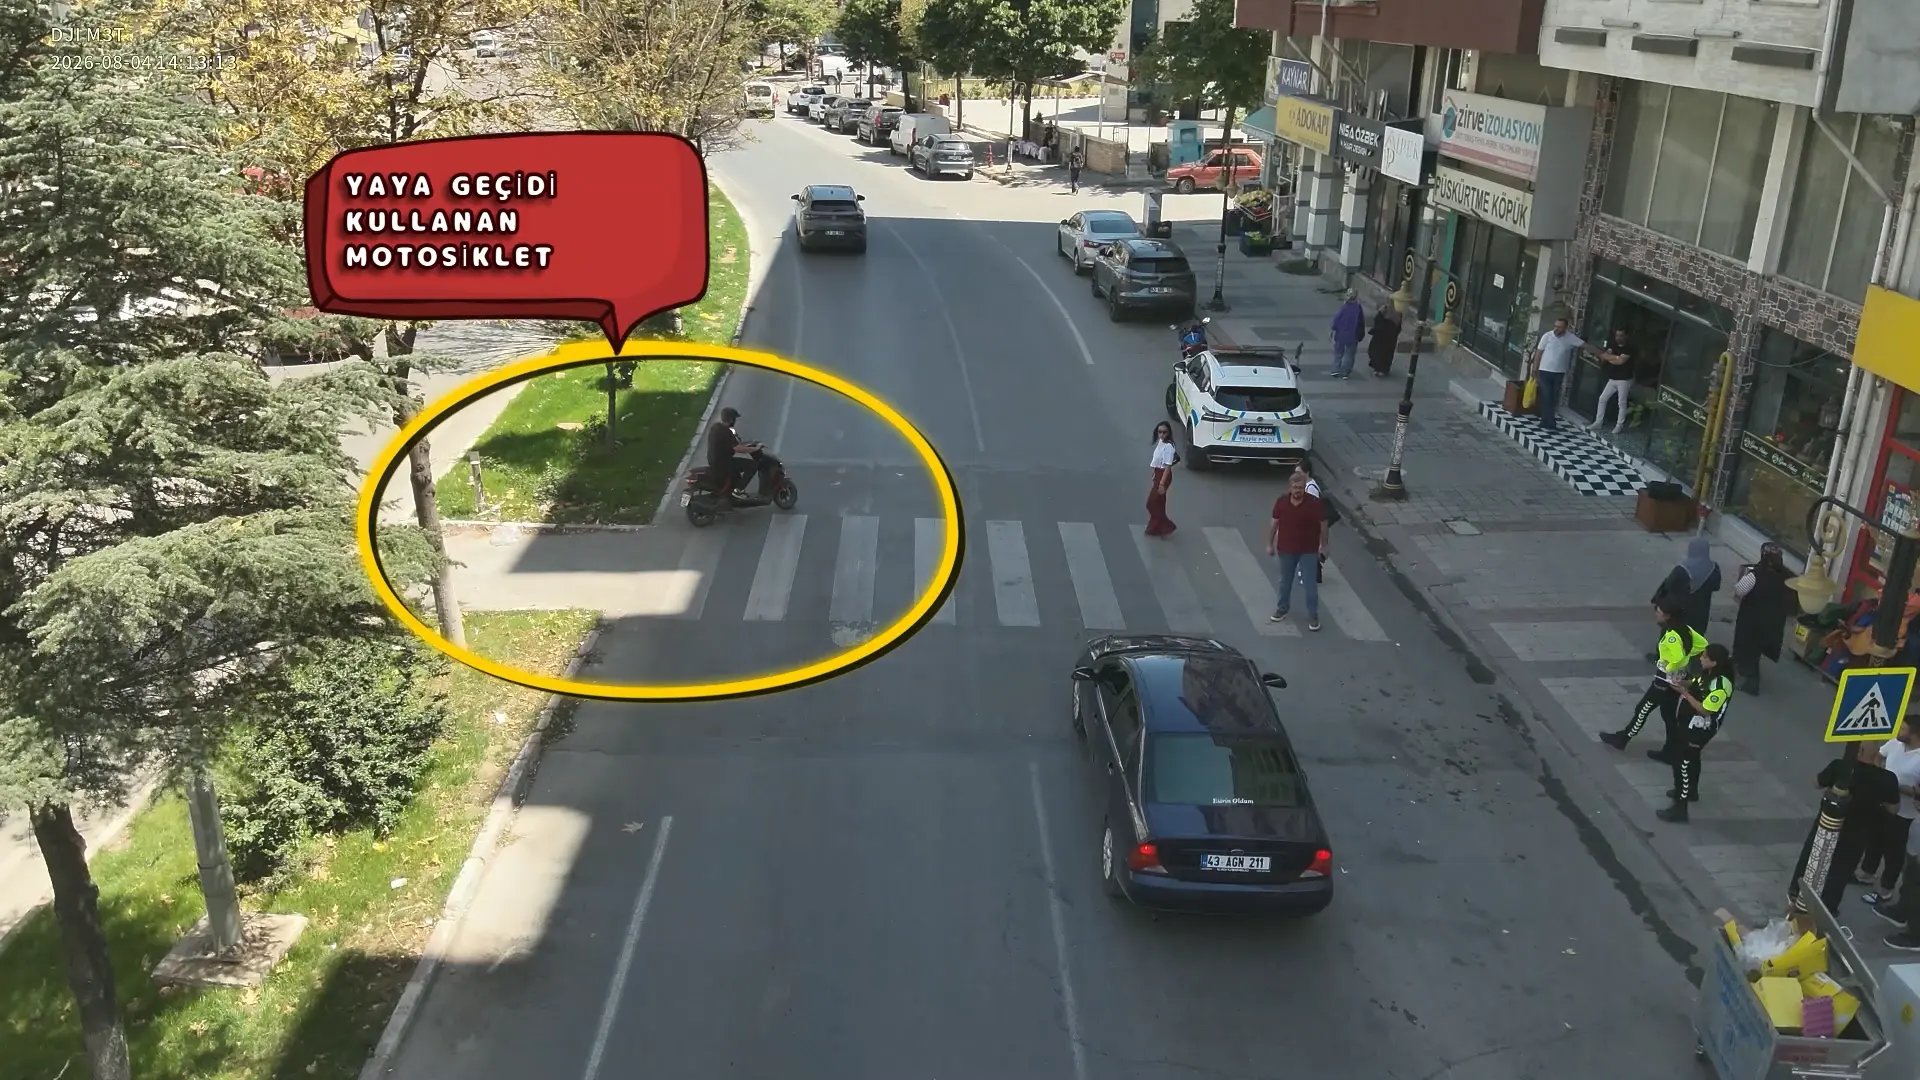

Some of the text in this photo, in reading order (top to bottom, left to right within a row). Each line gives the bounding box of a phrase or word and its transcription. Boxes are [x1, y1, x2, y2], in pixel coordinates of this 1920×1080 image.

[1282, 66, 1309, 91] KAYNAR
[1434, 173, 1528, 229] PÜSKÜRTME KÖPÜK
[1208, 856, 1264, 869] 43 AGN 211
